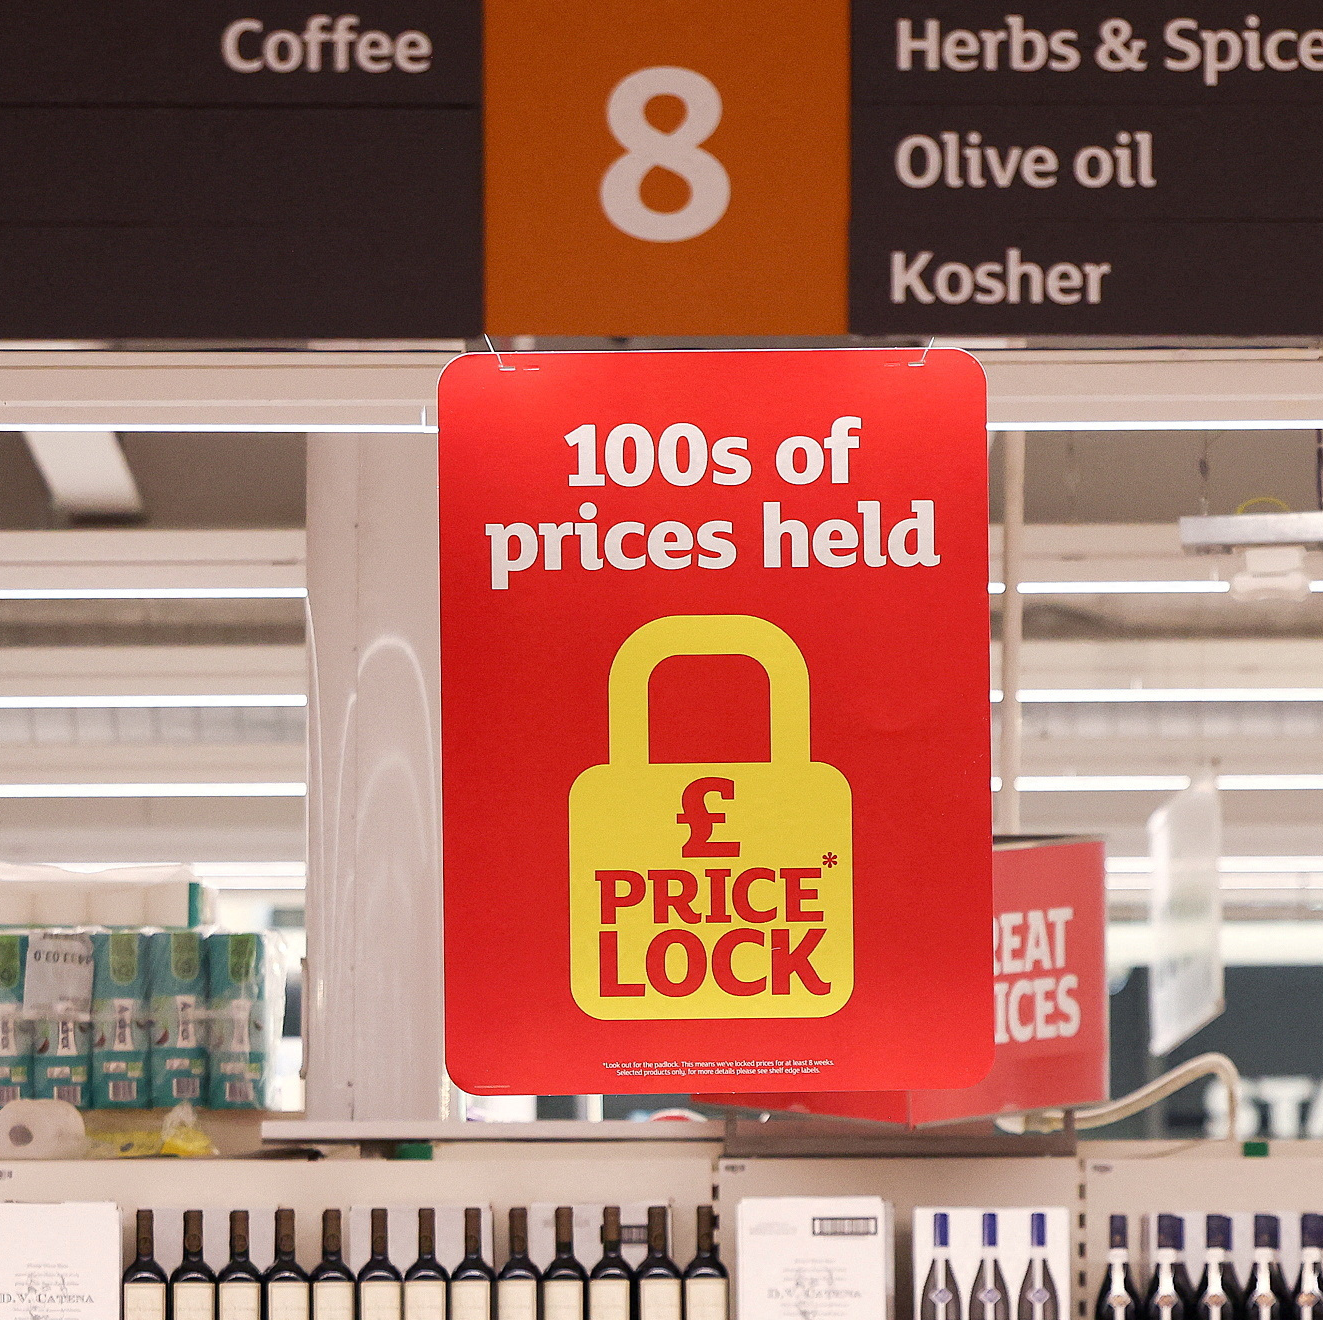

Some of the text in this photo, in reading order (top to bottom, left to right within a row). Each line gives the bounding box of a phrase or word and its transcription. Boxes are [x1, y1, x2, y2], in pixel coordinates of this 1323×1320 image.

[222, 16, 431, 72] Coffee
[896, 16, 1081, 72] Herbs
[1095, 19, 1148, 72] &
[599, 66, 731, 243] 8
[895, 132, 1158, 189] Olive oil
[890, 248, 1111, 305] Kosher
[563, 415, 863, 488] 100s of
[484, 499, 942, 590] prices held
[676, 776, 741, 859] £
[598, 927, 832, 998] LOCK
[643, 1069, 671, 1077] products
[784, 1067, 801, 1075] edge
